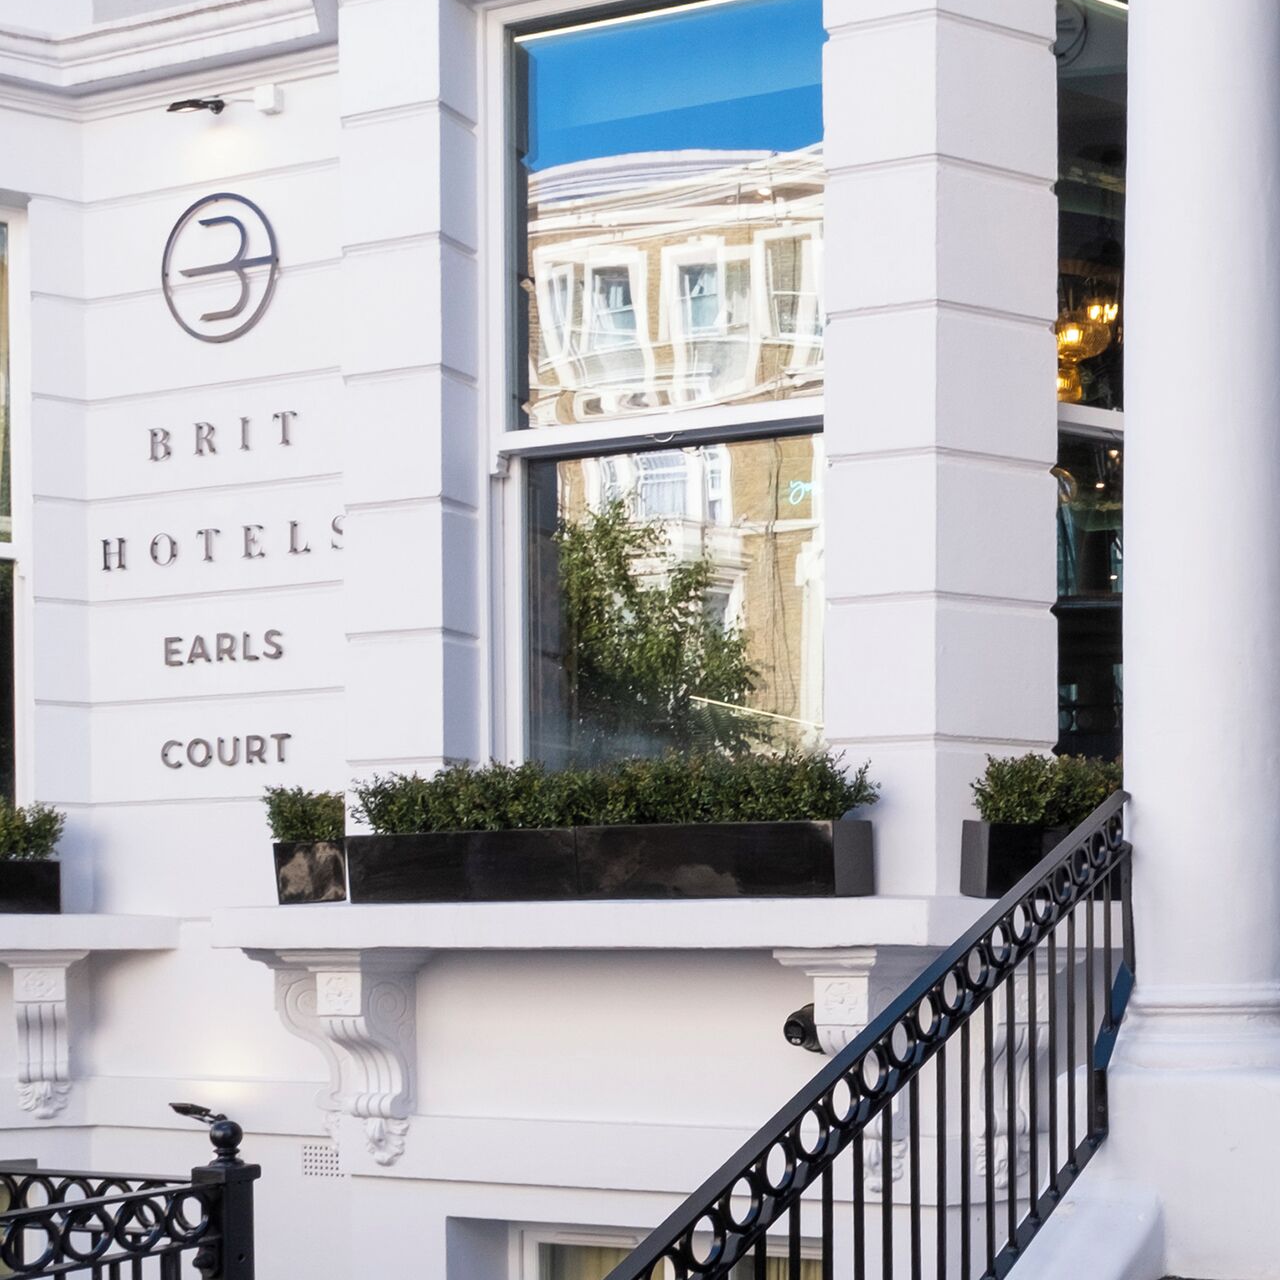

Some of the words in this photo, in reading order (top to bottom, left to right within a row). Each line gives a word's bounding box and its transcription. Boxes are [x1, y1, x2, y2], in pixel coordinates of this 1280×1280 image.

[148, 410, 298, 462] BRIT
[164, 629, 284, 668] EARLS
[161, 733, 292, 770] COURT
